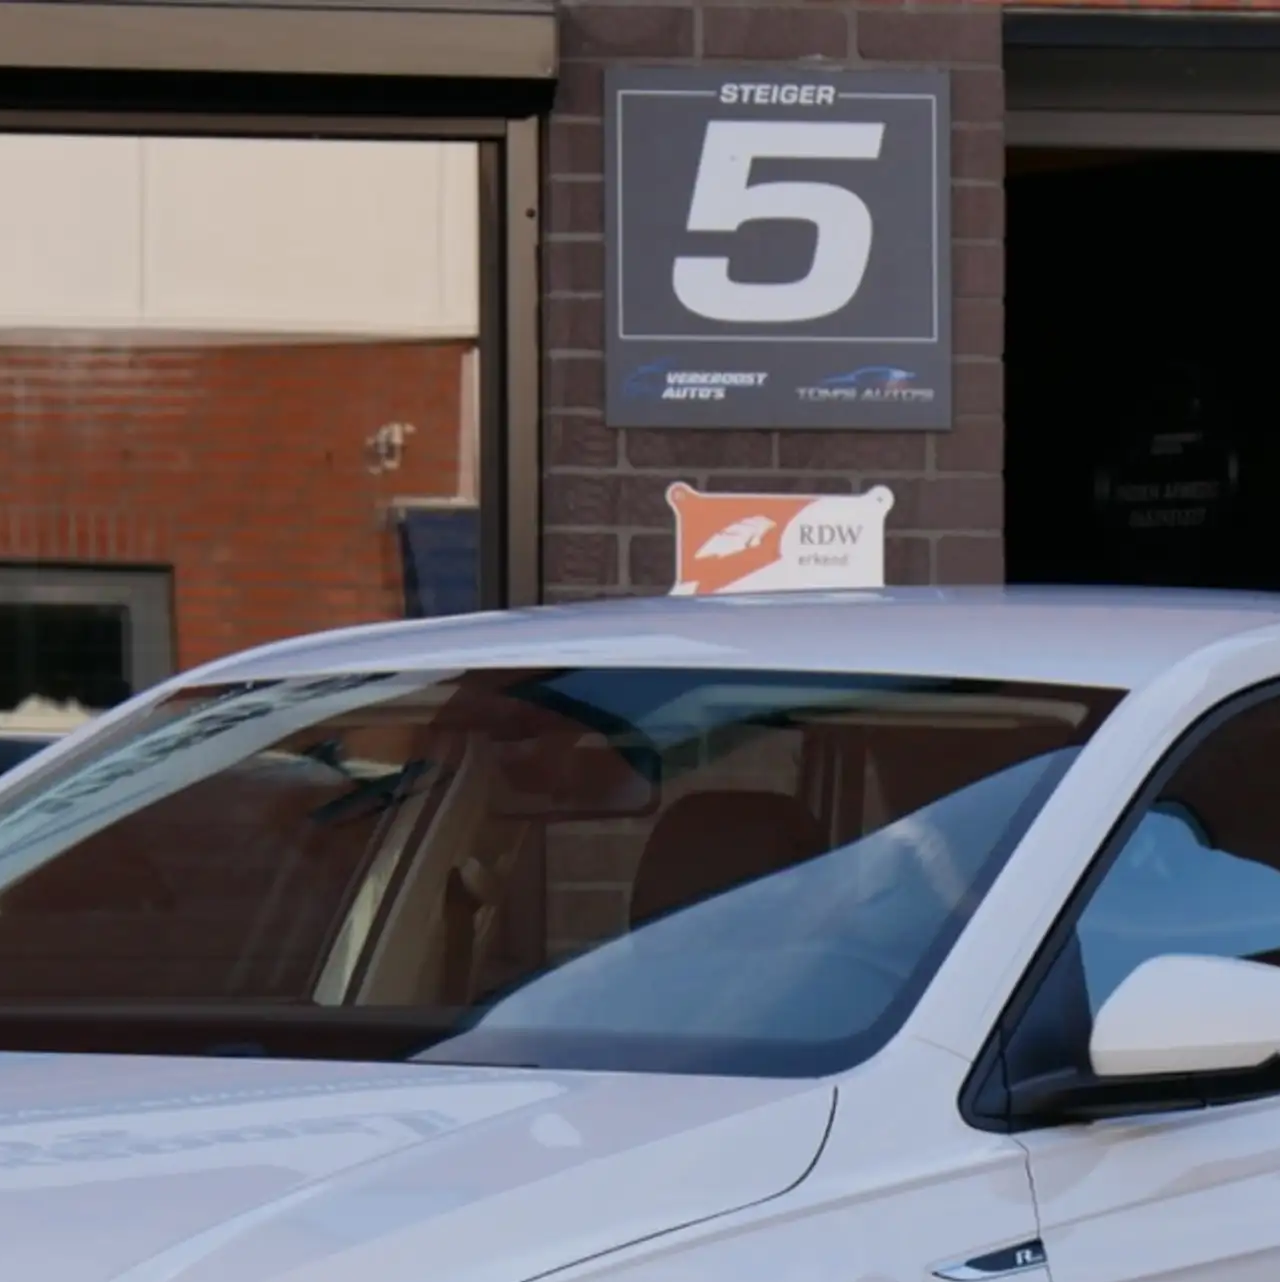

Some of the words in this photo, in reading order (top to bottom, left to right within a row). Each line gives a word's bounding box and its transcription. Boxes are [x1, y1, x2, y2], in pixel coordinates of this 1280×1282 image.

[719, 83, 837, 105] STEIGER
[673, 120, 885, 323] 5
[665, 372, 767, 386] VERKROOST
[662, 387, 726, 400] AUTO'S
[798, 524, 864, 545] RDW
